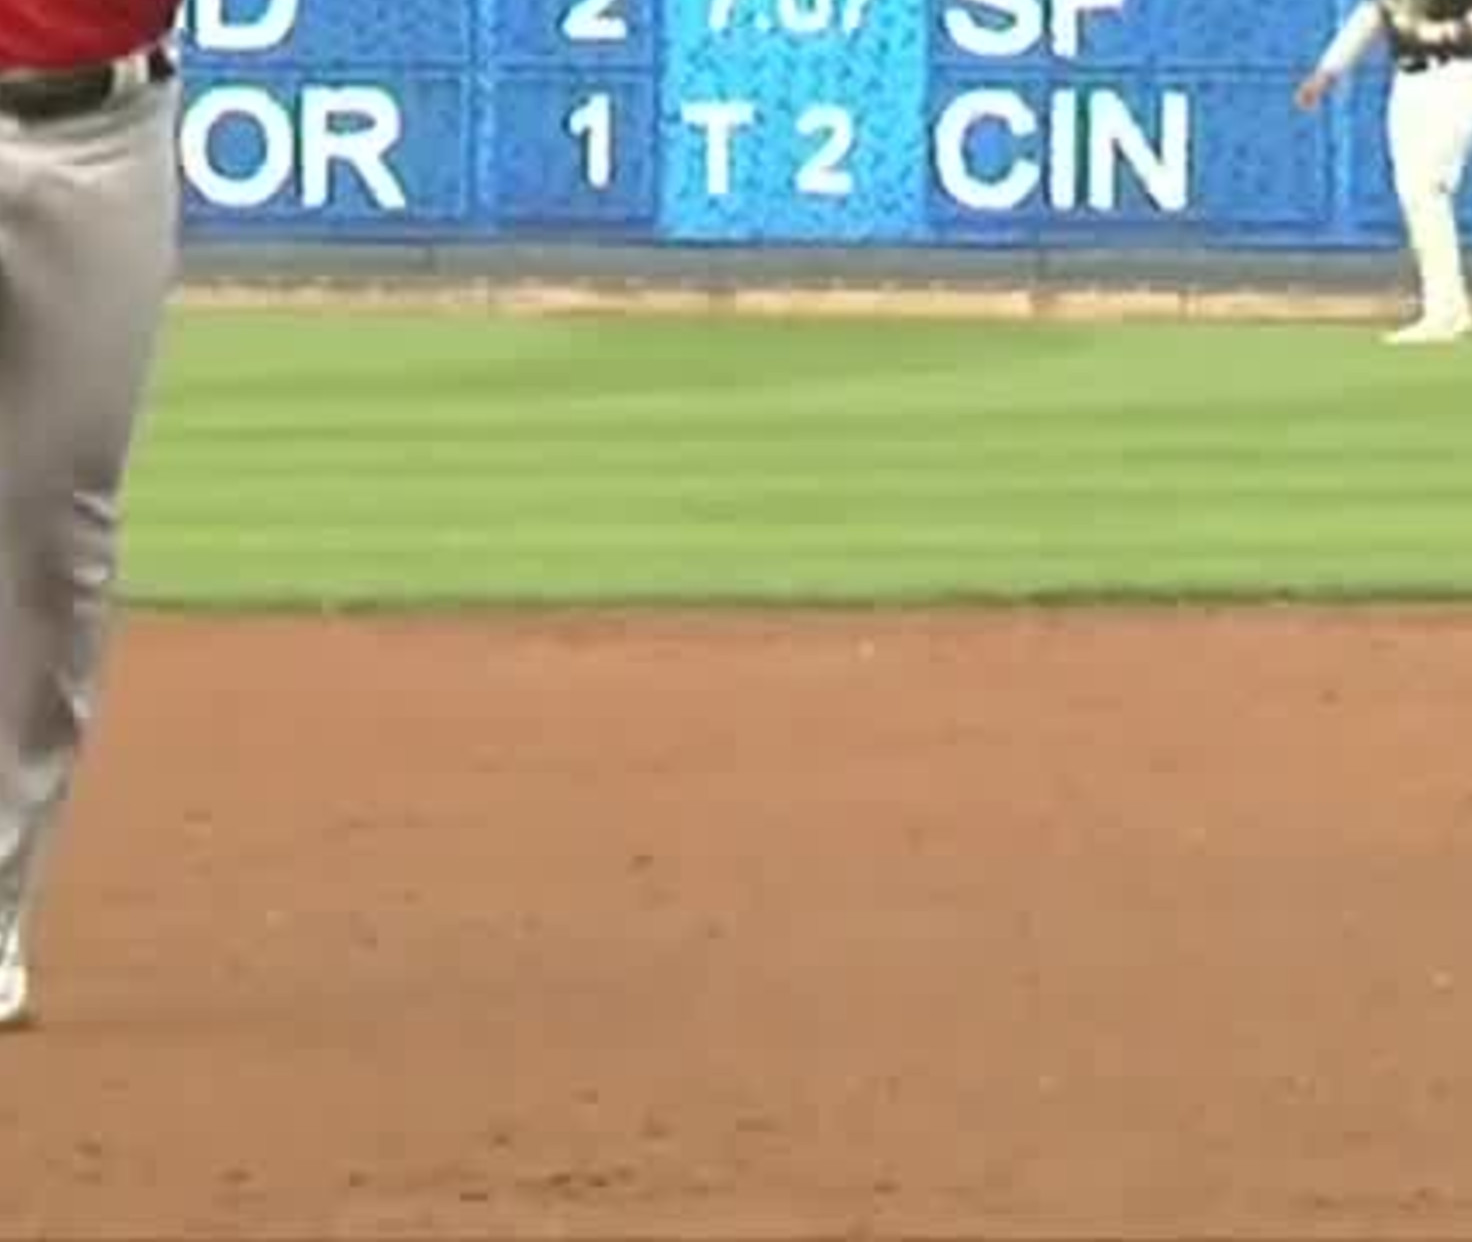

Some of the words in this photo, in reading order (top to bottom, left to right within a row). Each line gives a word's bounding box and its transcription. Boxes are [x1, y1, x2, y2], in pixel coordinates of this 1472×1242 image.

[179, 87, 406, 209] OR
[570, 95, 610, 187] 1
[682, 101, 753, 195] T
[797, 106, 853, 195] 2
[936, 90, 1189, 212] CIN
